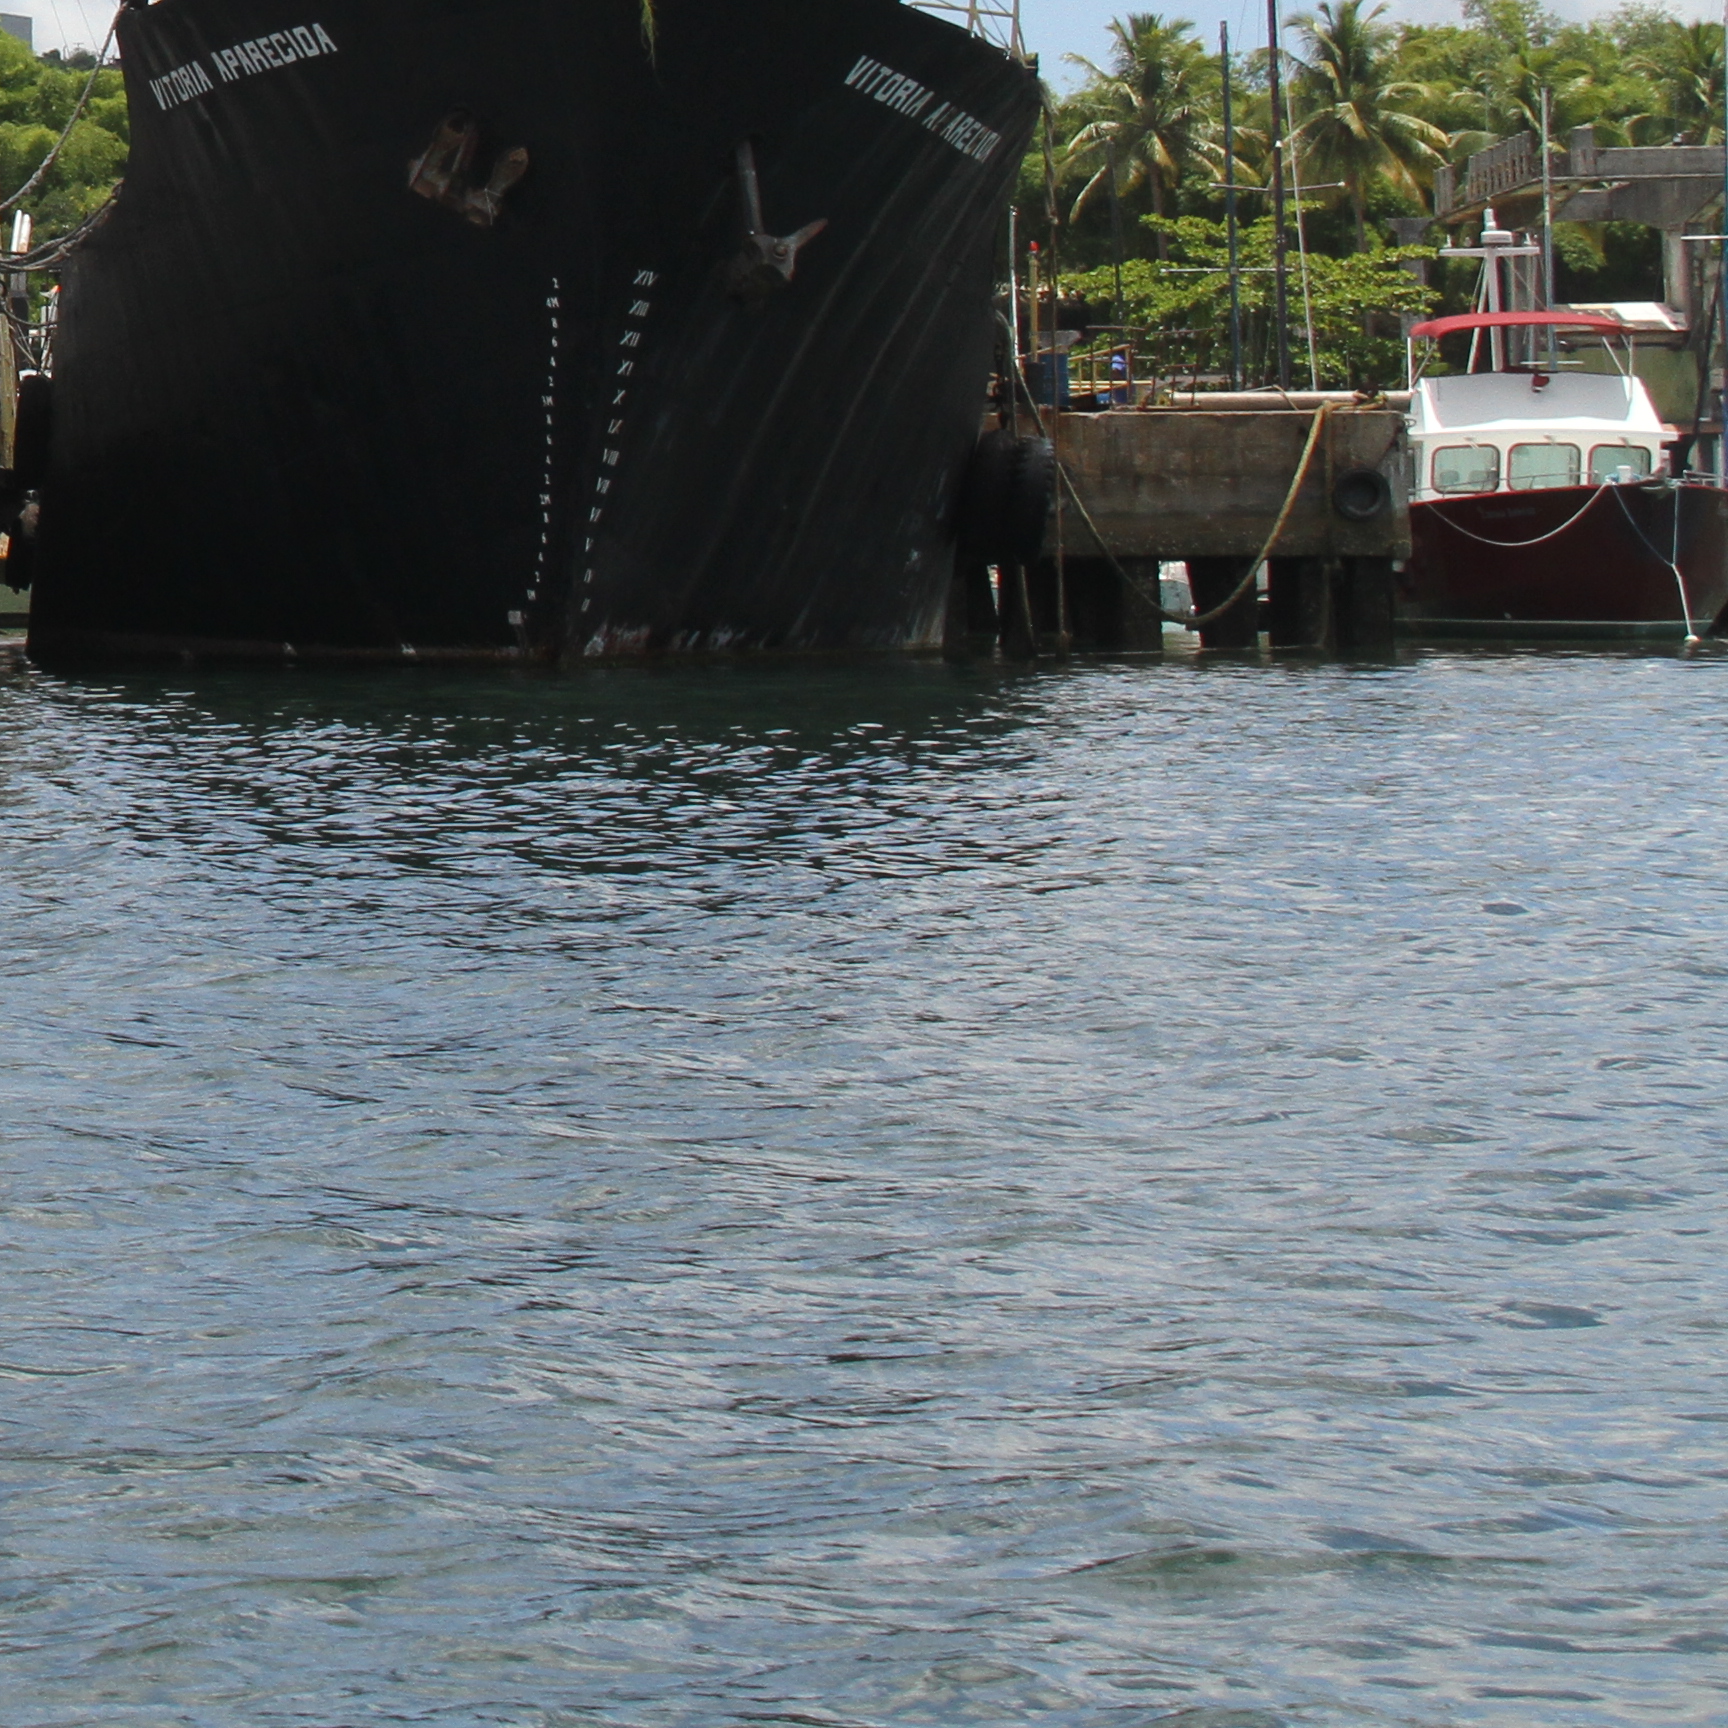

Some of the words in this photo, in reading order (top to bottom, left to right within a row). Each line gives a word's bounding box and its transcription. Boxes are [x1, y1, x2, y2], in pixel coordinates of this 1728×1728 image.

[149, 60, 214, 110] VITORIA
[210, 23, 338, 83] APARECIDA
[844, 54, 936, 119] VITORIA
[633, 269, 660, 287] XIV
[619, 330, 641, 347] XII
[617, 359, 634, 376] XI
[612, 389, 626, 405] X
